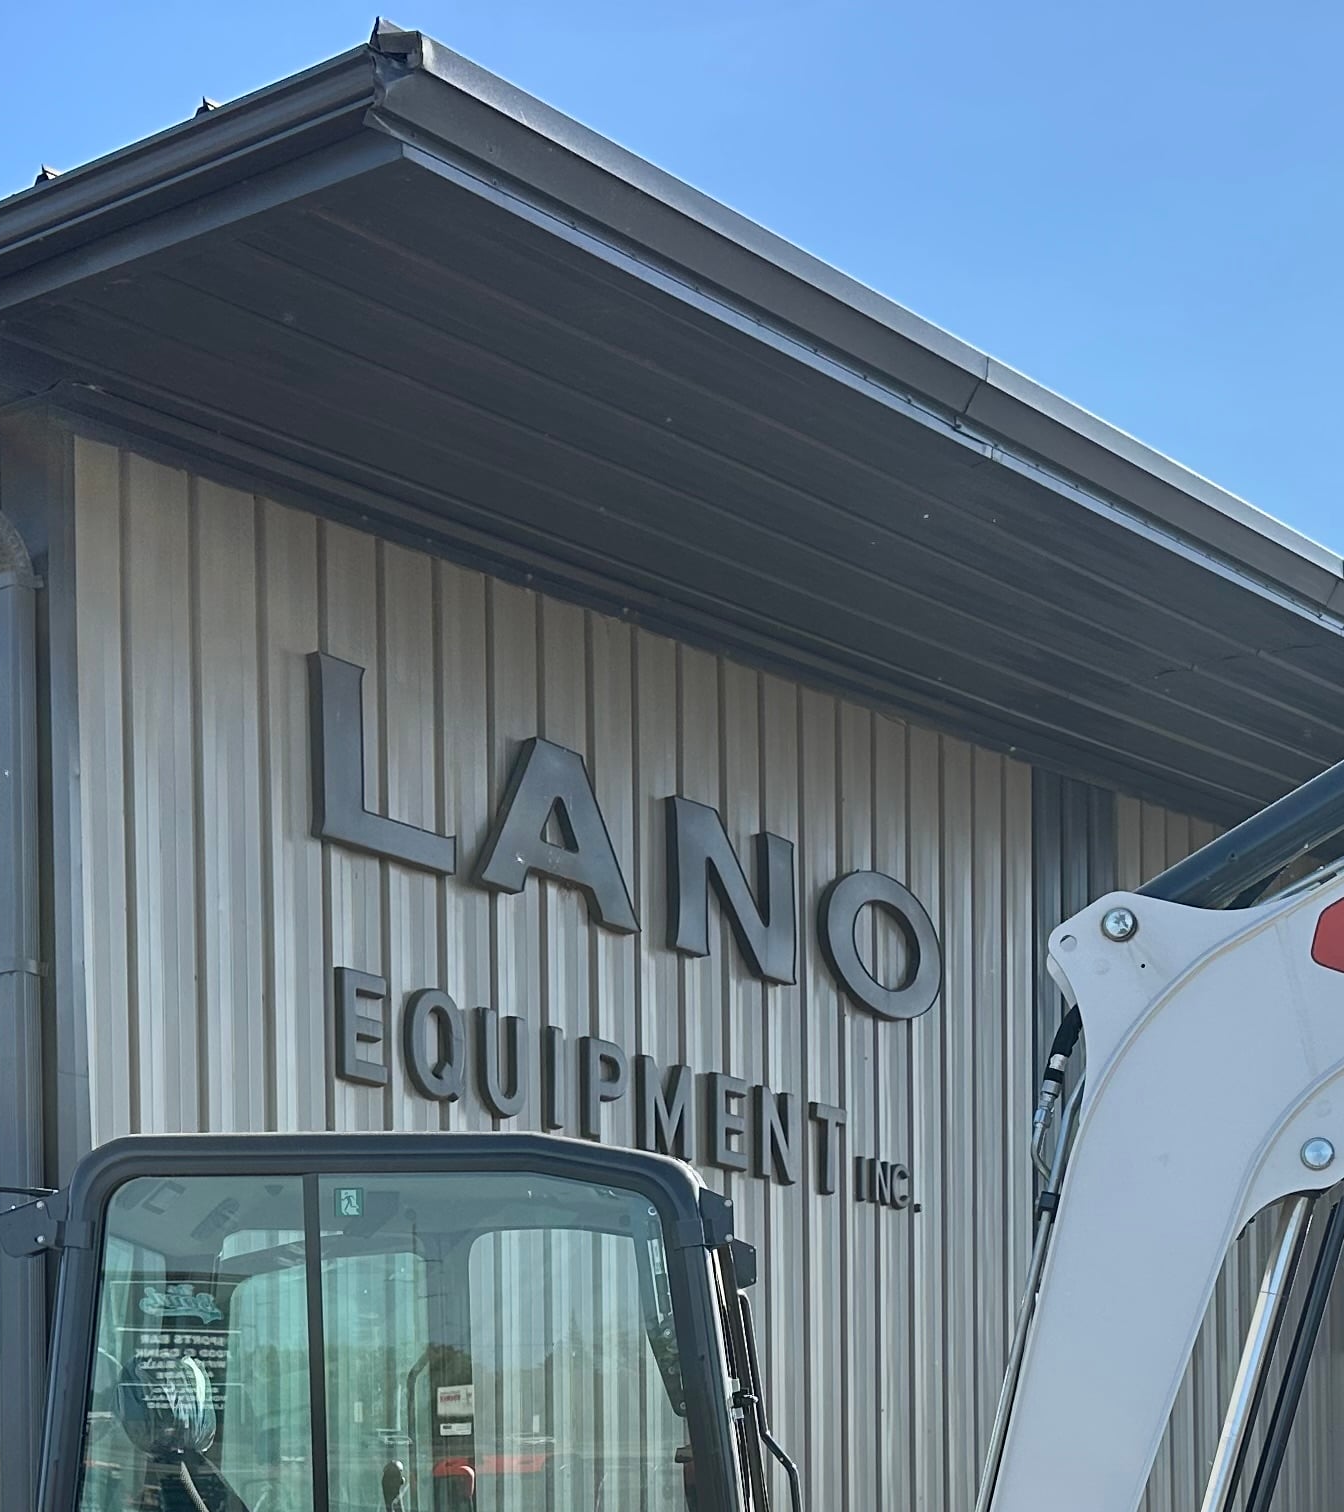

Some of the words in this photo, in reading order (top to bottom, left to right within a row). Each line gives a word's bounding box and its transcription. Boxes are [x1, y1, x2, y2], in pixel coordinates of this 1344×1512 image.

[307, 652, 943, 1021] LANO
[334, 966, 847, 1195] EQUIPMENT
[853, 1156, 922, 1213] INC.
